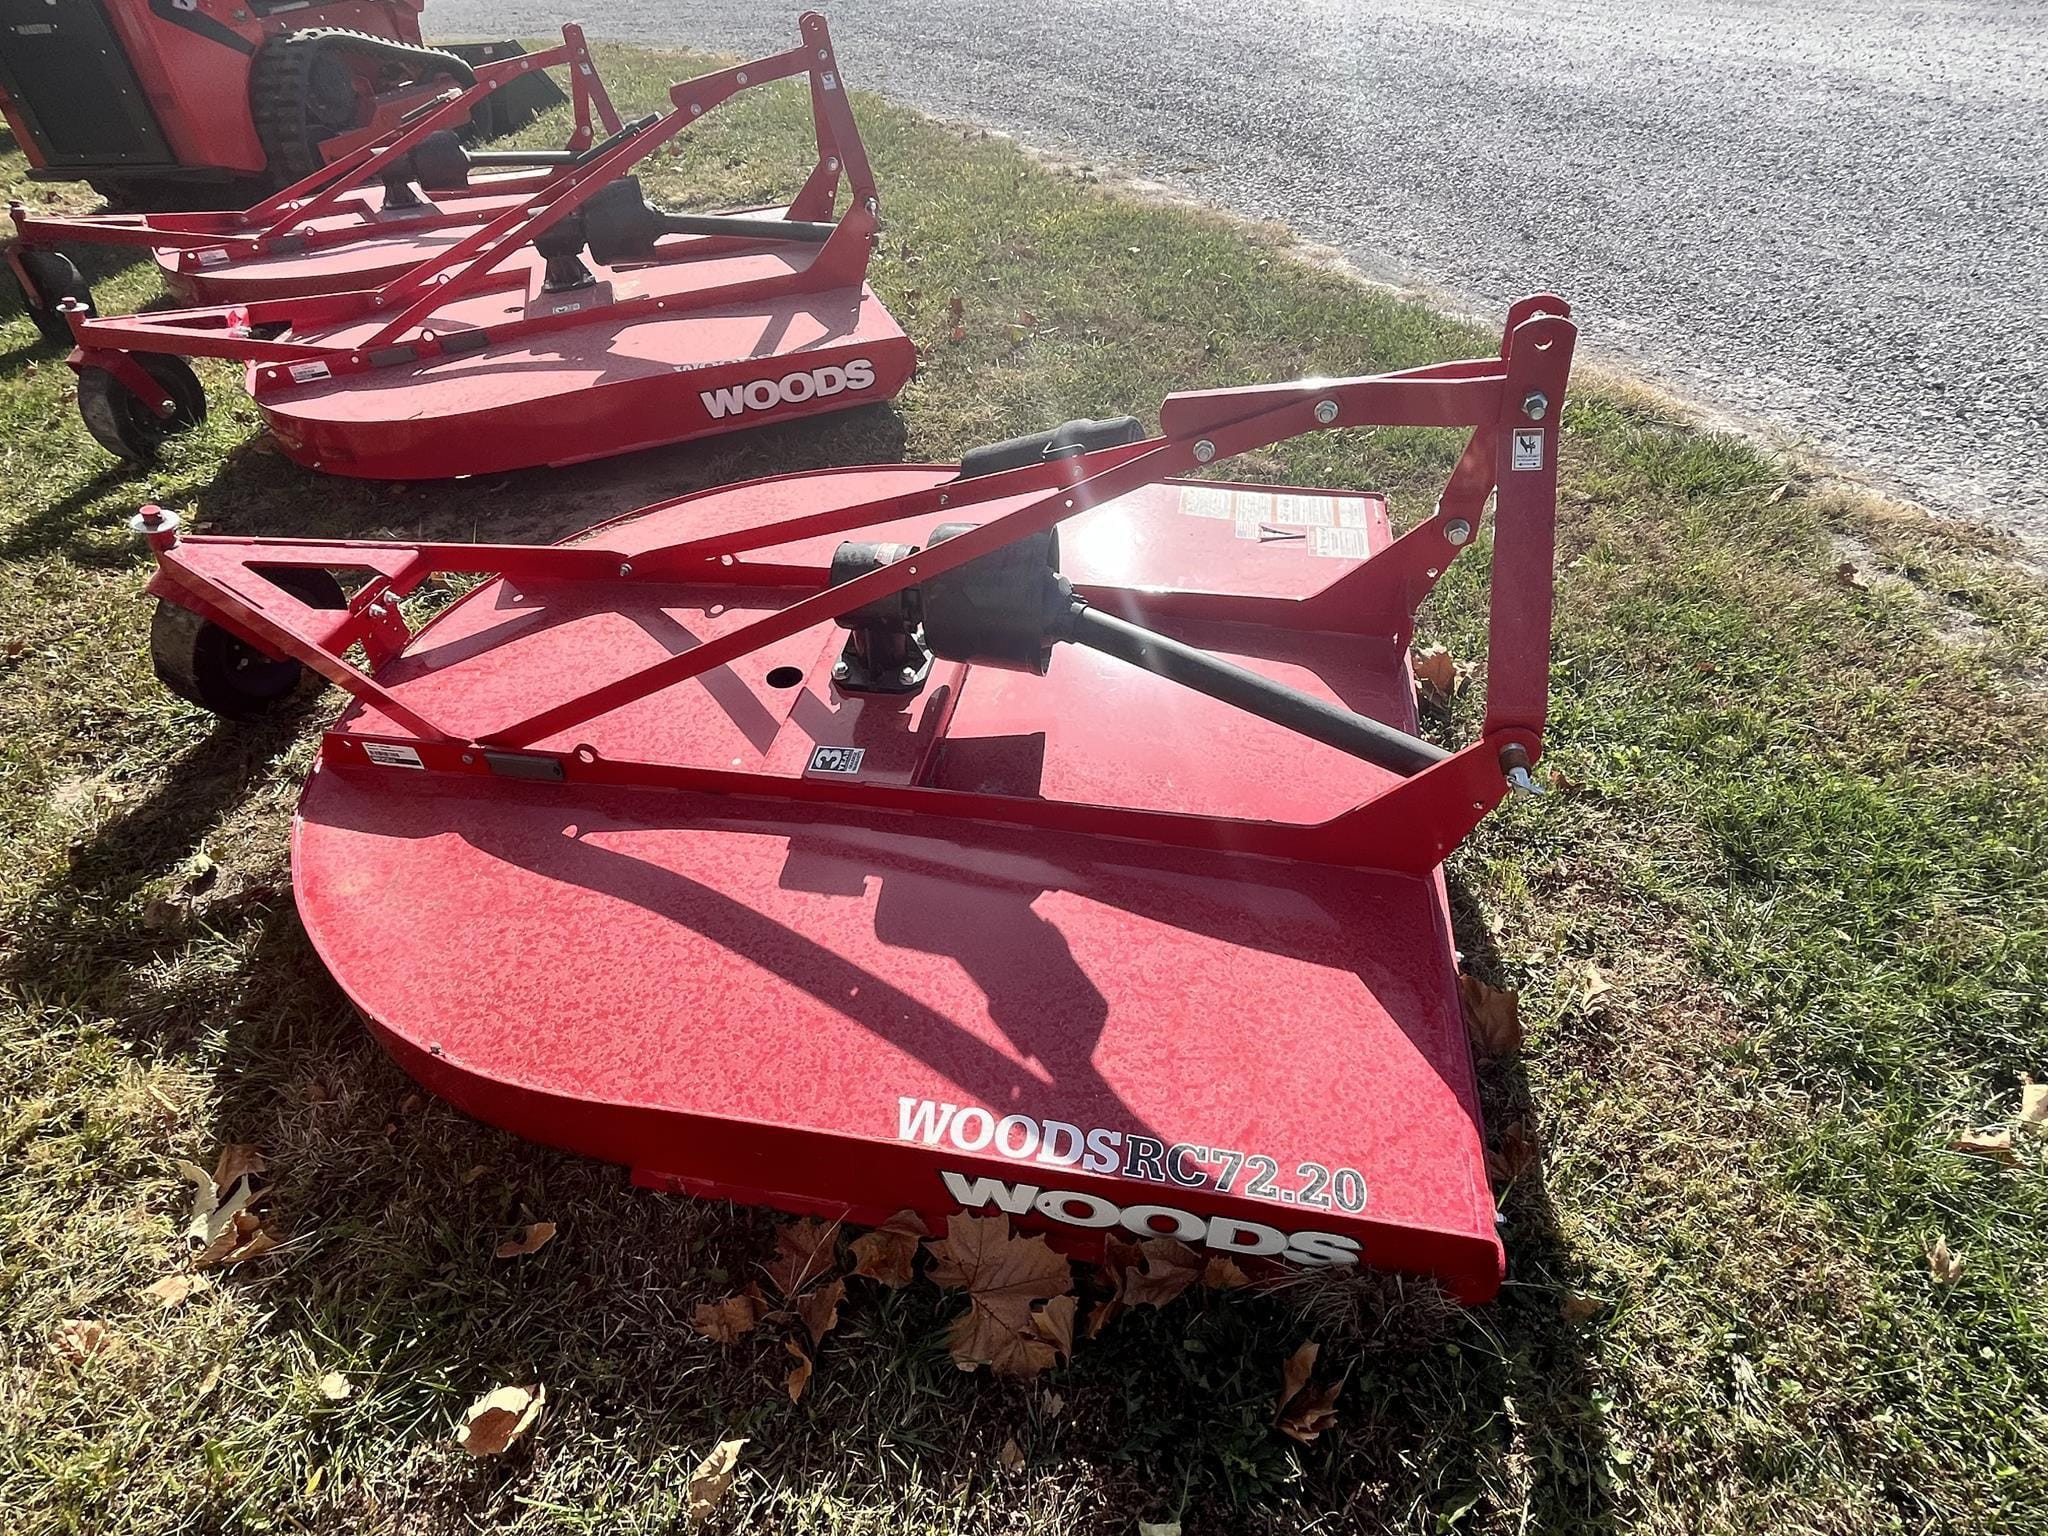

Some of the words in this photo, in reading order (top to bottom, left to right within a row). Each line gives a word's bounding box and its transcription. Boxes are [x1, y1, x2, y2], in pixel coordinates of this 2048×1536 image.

[700, 358, 876, 419] WOODS
[814, 749, 842, 769] 3
[940, 1169, 1363, 1267] WOODS
